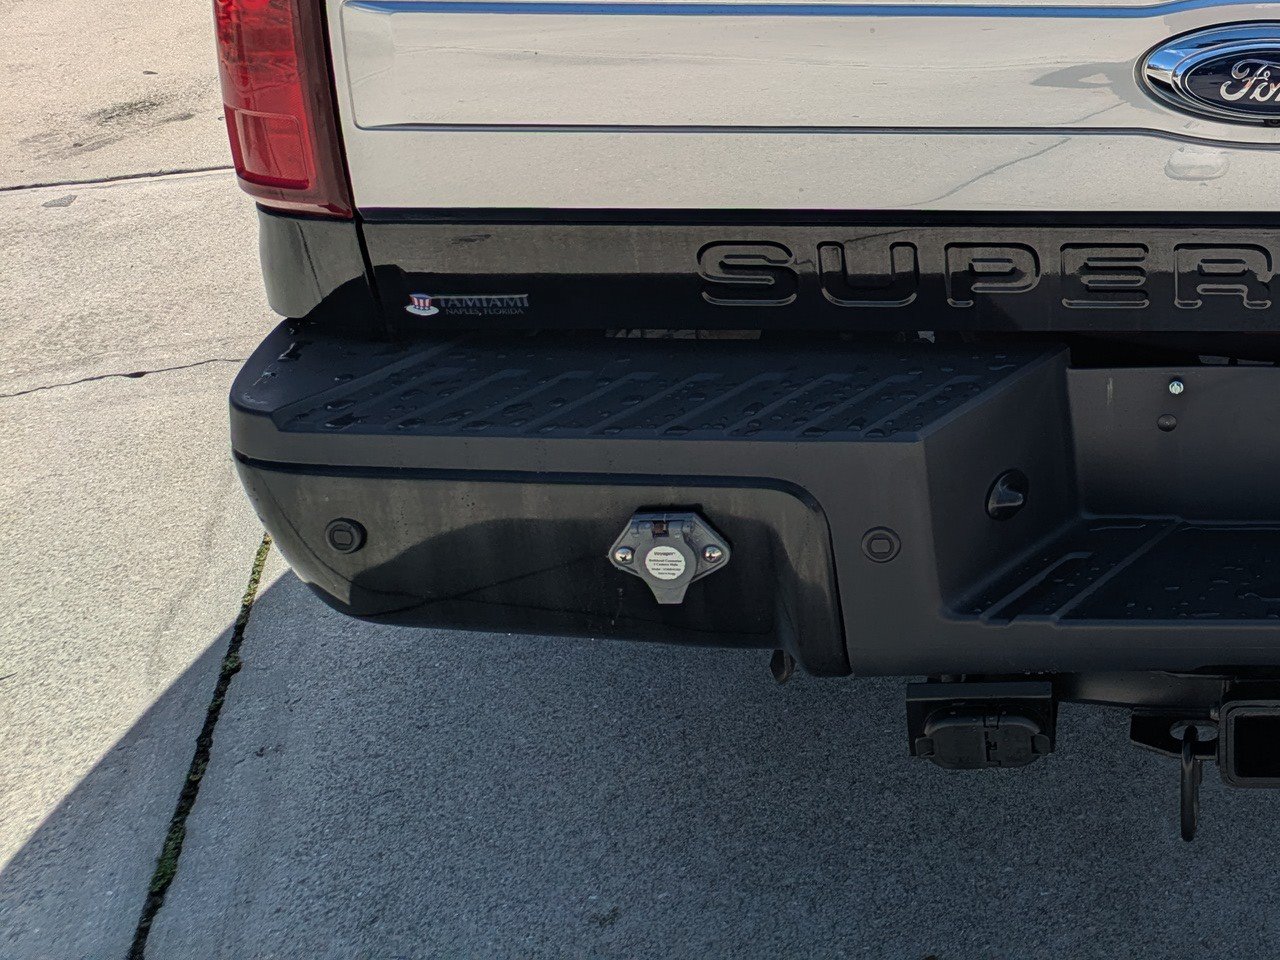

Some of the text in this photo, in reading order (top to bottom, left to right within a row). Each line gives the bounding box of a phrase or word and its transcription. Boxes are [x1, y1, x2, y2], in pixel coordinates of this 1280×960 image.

[697, 241, 1272, 308] SUPER
[440, 294, 530, 308] TAMIAMI
[483, 307, 525, 315] FLORIDA
